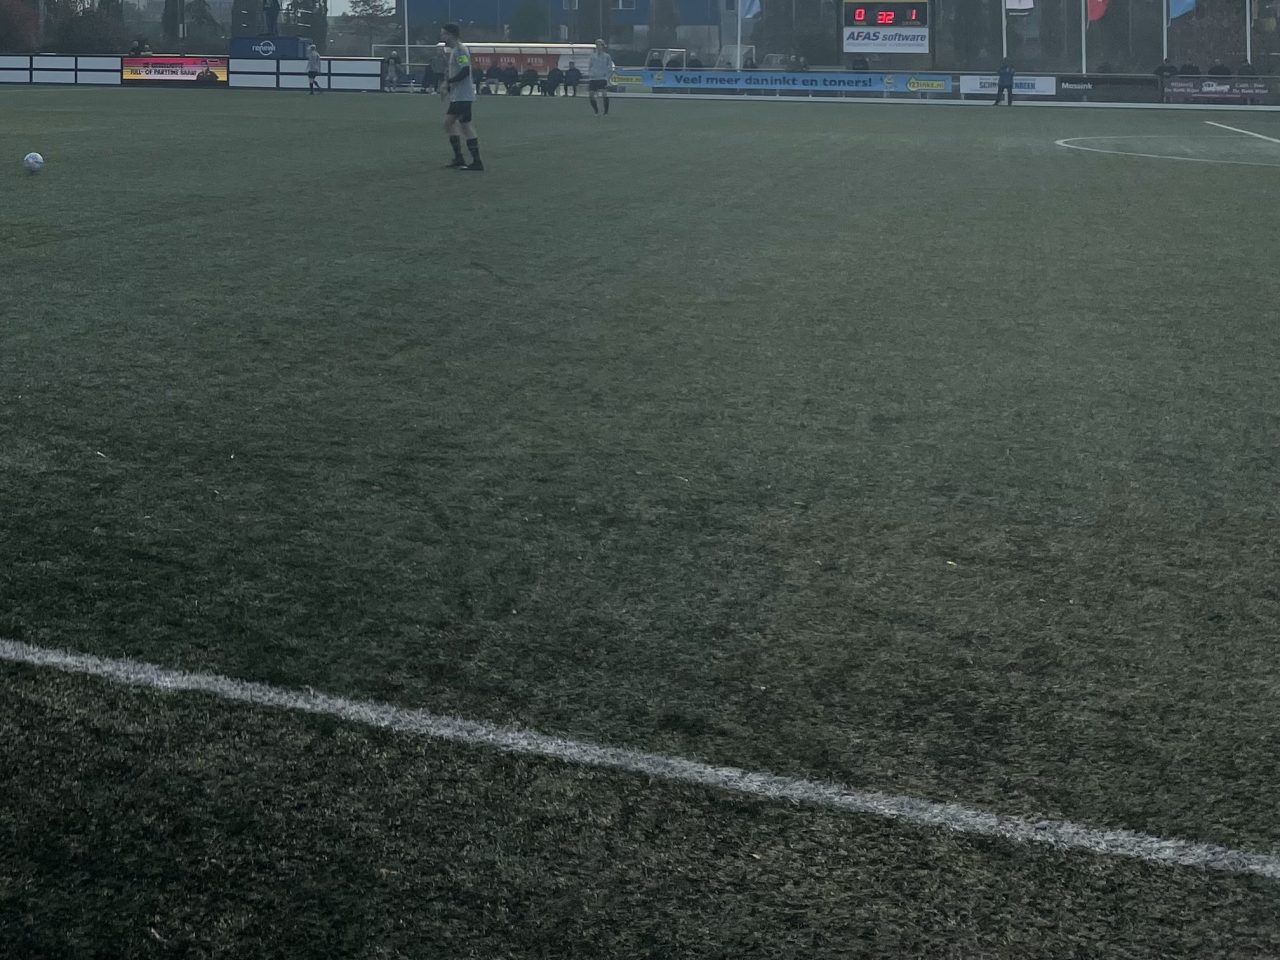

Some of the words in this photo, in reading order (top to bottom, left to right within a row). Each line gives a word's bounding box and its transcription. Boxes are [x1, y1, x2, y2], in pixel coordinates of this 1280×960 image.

[854, 8, 866, 21] 0
[877, 11, 895, 24] 32
[846, 31, 880, 41] AFAS
[882, 33, 926, 42] software
[252, 44, 276, 52] renewi
[675, 74, 701, 84] Veel
[706, 76, 740, 85] meer
[802, 78, 818, 86] en
[823, 77, 872, 87] toners!
